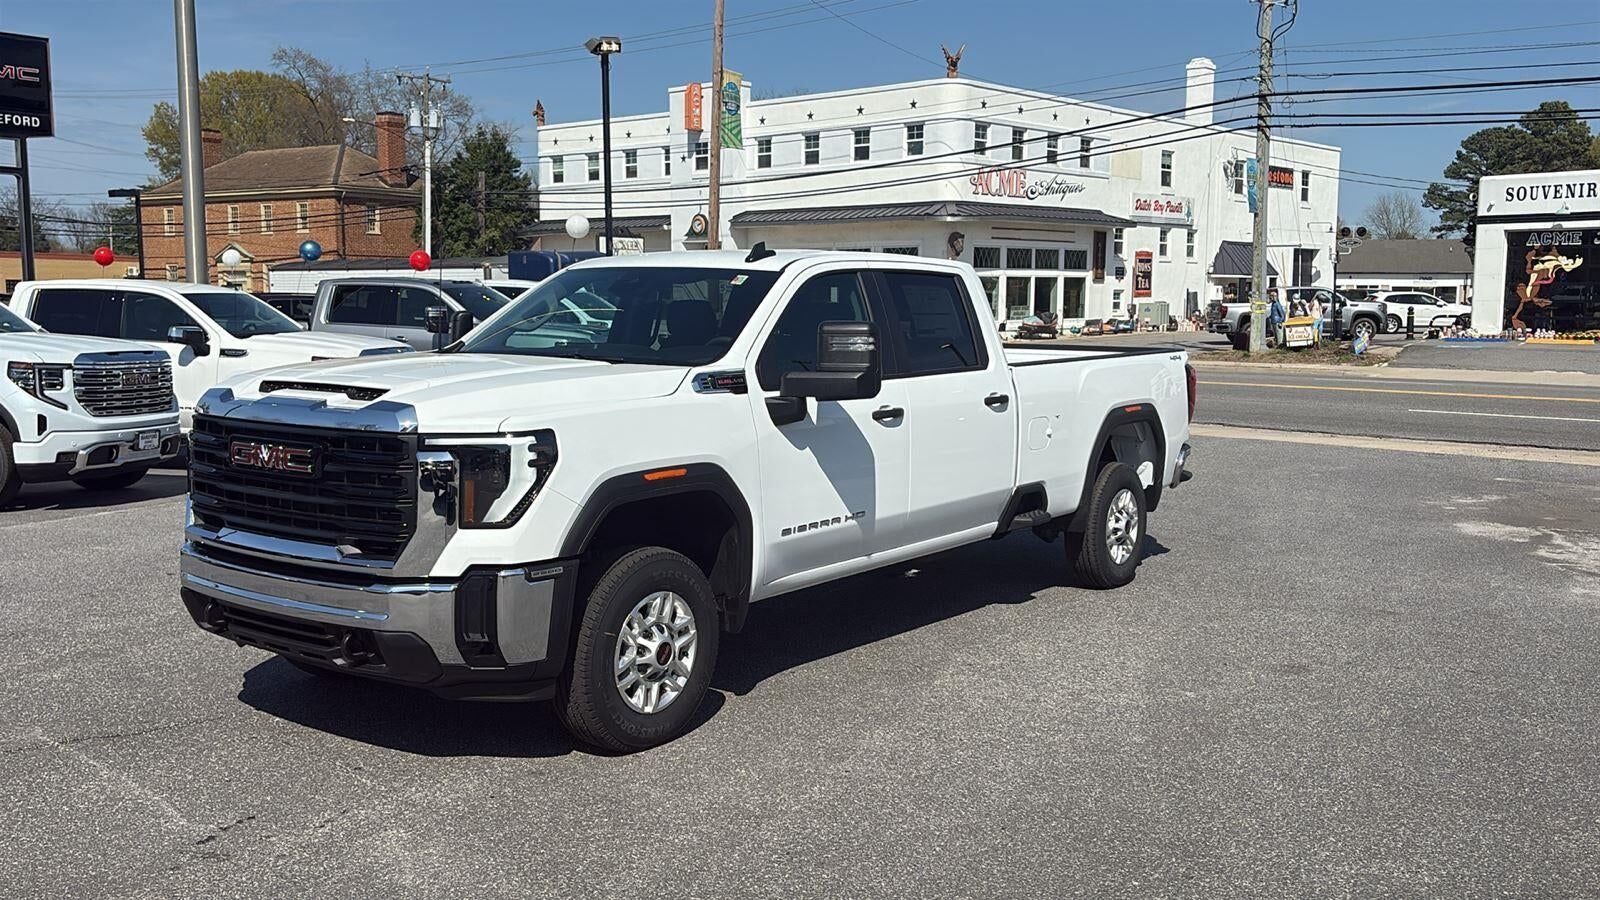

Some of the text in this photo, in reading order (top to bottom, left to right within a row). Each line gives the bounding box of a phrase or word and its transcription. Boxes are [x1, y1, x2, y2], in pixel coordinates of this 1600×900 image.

[0, 65, 40, 82] MC
[970, 167, 1027, 199] ACME
[1039, 174, 1086, 202] Antiques
[1135, 198, 1183, 215] Dutch Boy Paints
[1526, 231, 1583, 246] ACME
[1137, 276, 1150, 289] TEA
[231, 441, 313, 473] GMC
[781, 510, 866, 537] SIERRA HD
